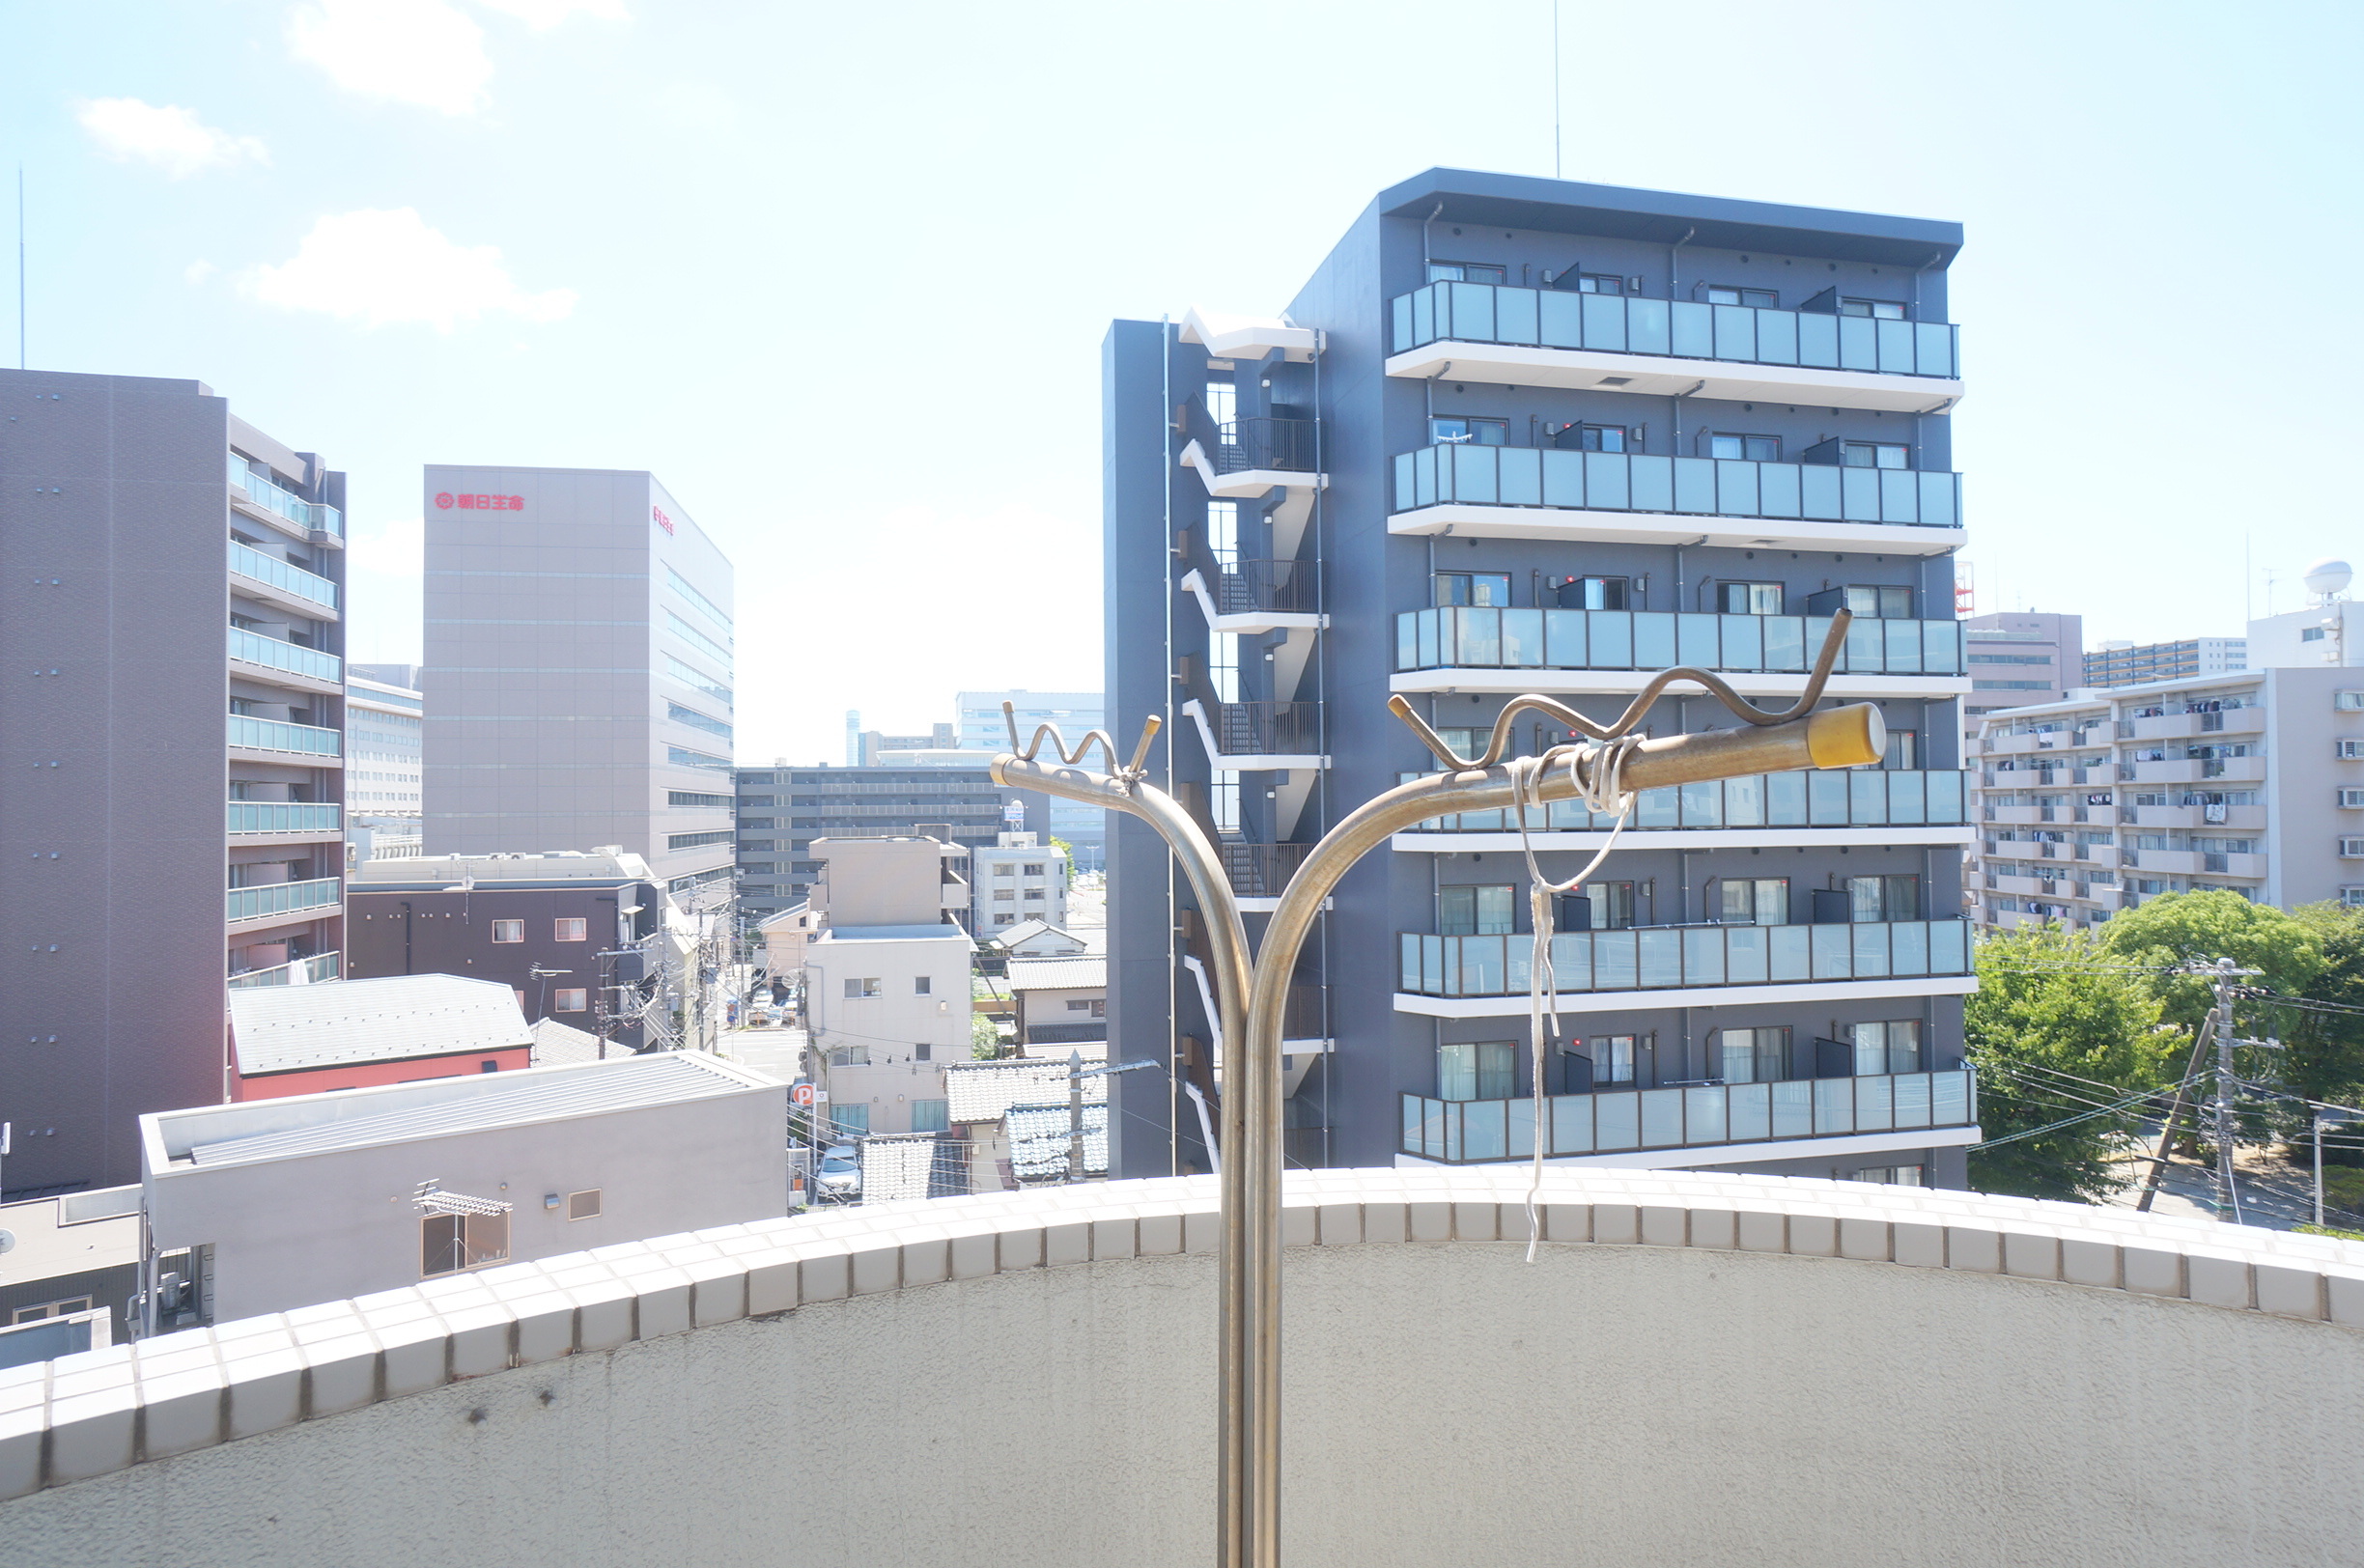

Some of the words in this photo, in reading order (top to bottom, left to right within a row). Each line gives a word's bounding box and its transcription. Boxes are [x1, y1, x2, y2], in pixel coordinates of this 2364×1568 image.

[457, 493, 525, 511] 朝日生命
[799, 1087, 812, 1105] P
